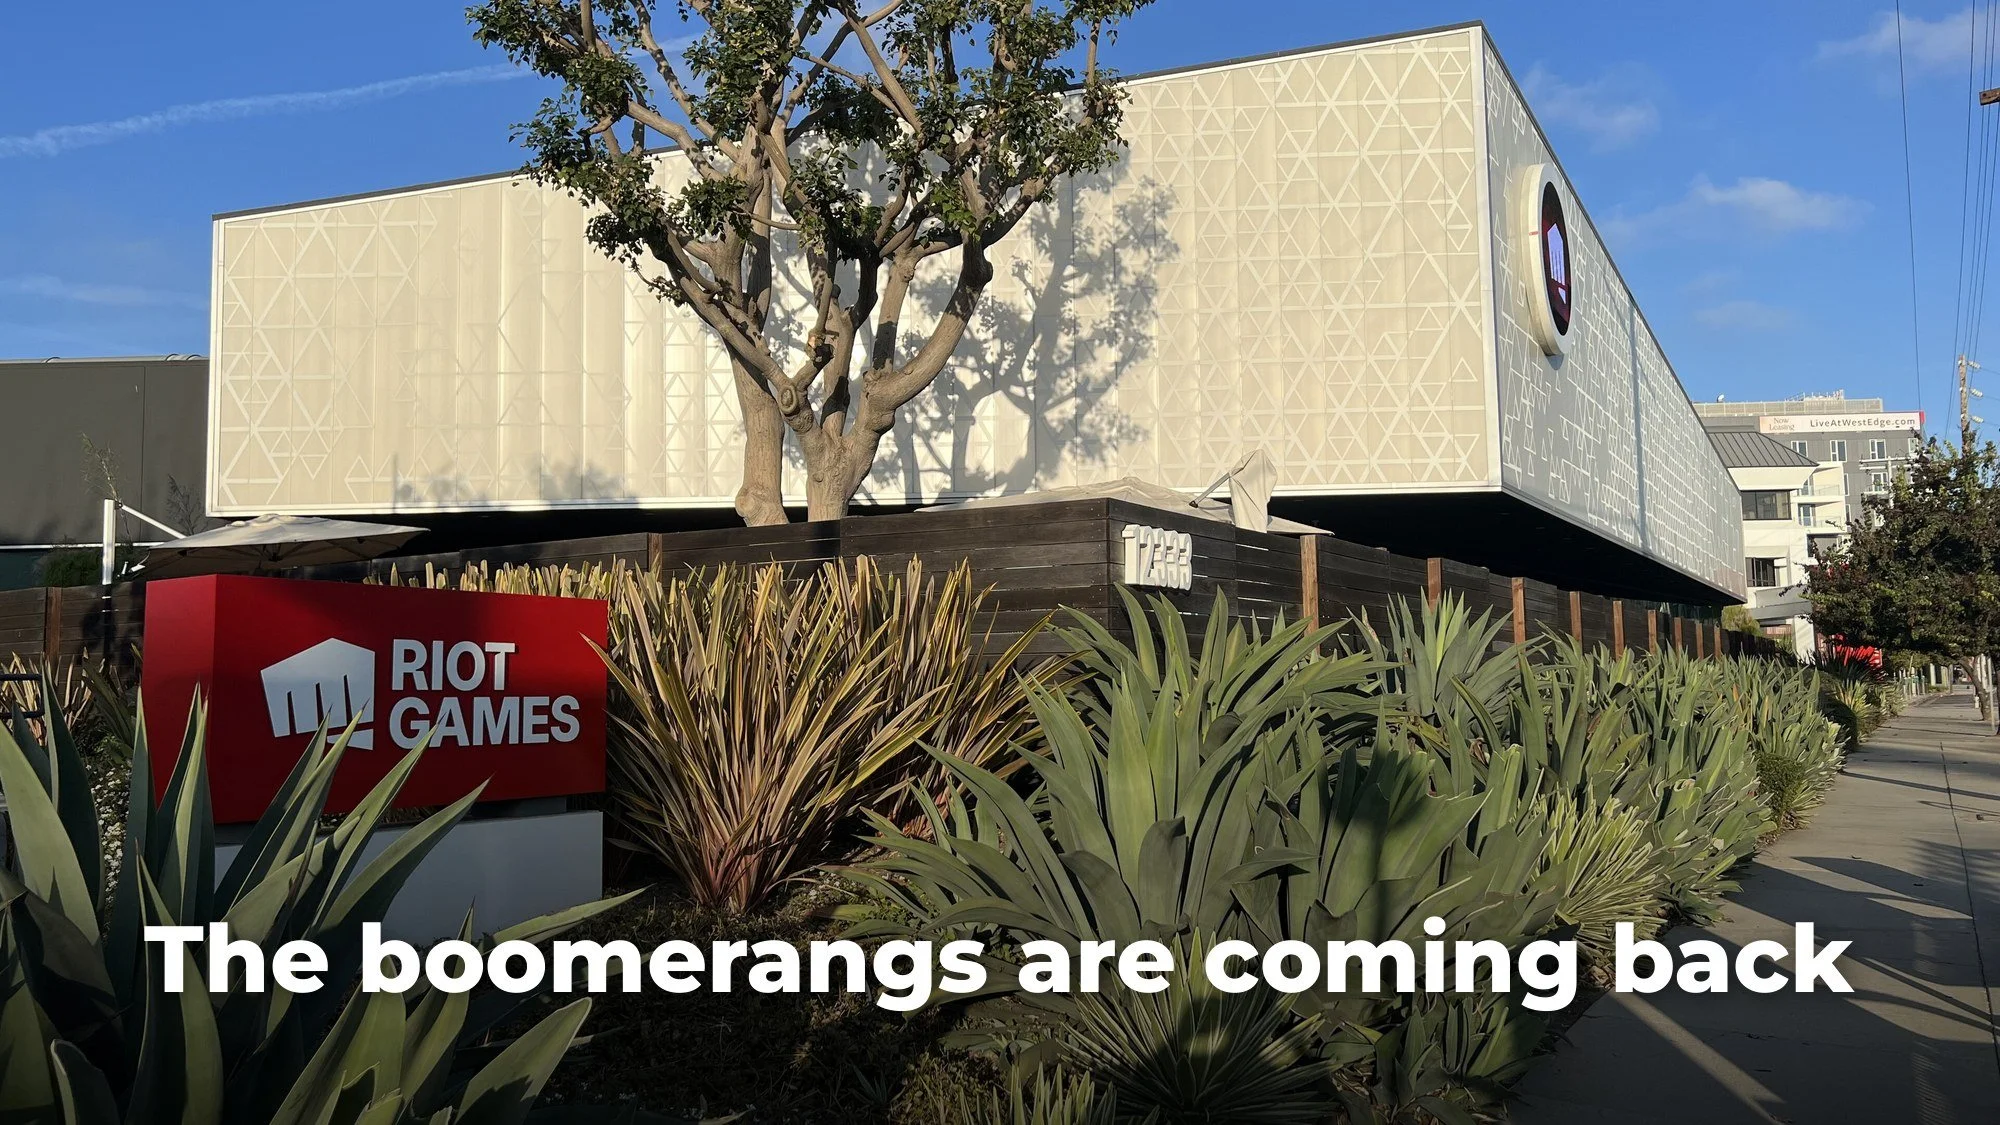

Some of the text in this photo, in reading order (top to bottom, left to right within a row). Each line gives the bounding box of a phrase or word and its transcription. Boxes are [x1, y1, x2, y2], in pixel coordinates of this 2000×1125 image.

[1769, 423, 1795, 431] Leasing
[1810, 418, 1915, 428] LiveAtWestEdge.com
[1121, 524, 1192, 591] 12333
[391, 639, 516, 692] RIOT
[389, 695, 580, 750] GAMES
